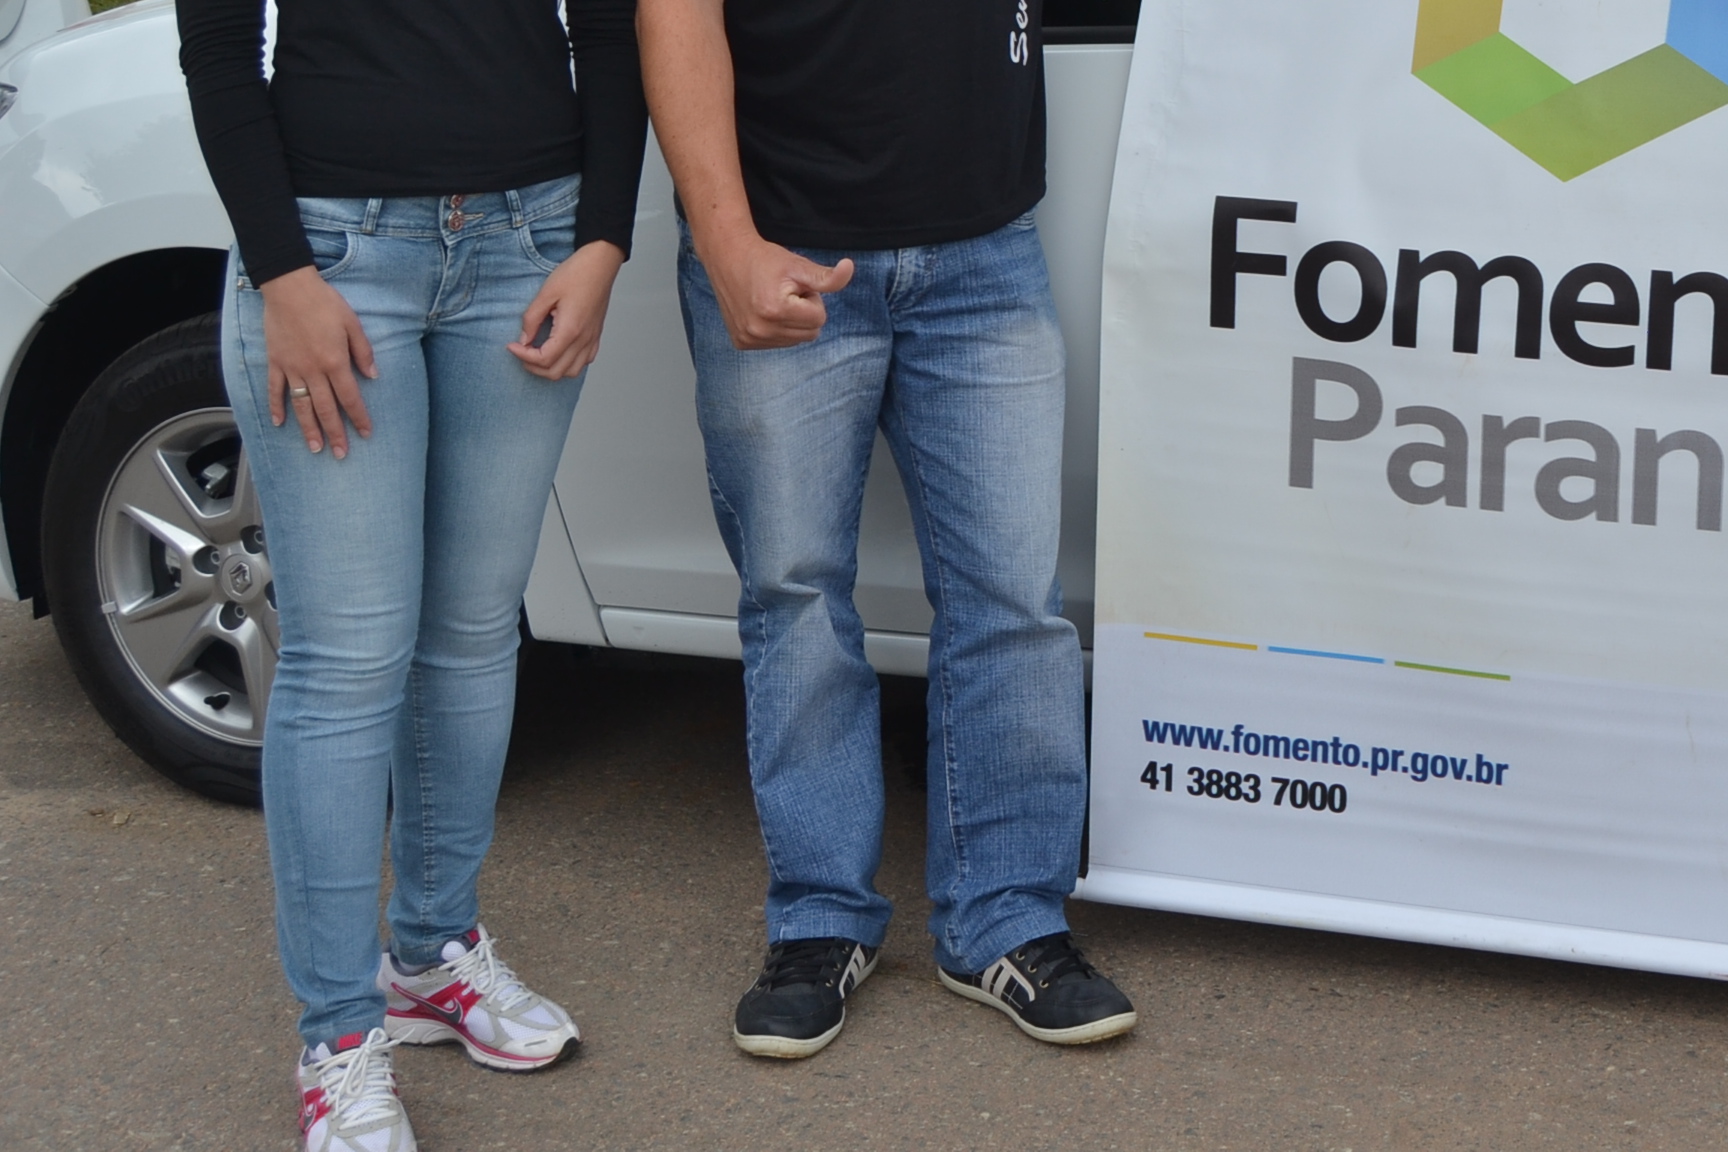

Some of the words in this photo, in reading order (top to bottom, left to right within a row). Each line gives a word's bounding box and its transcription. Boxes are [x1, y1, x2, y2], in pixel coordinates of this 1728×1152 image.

[1141, 718, 1509, 786] www.fomento.pr.gov.br
[1139, 760, 1174, 793] 41
[1186, 766, 1262, 804] 3883
[1270, 776, 1348, 814] 7000
